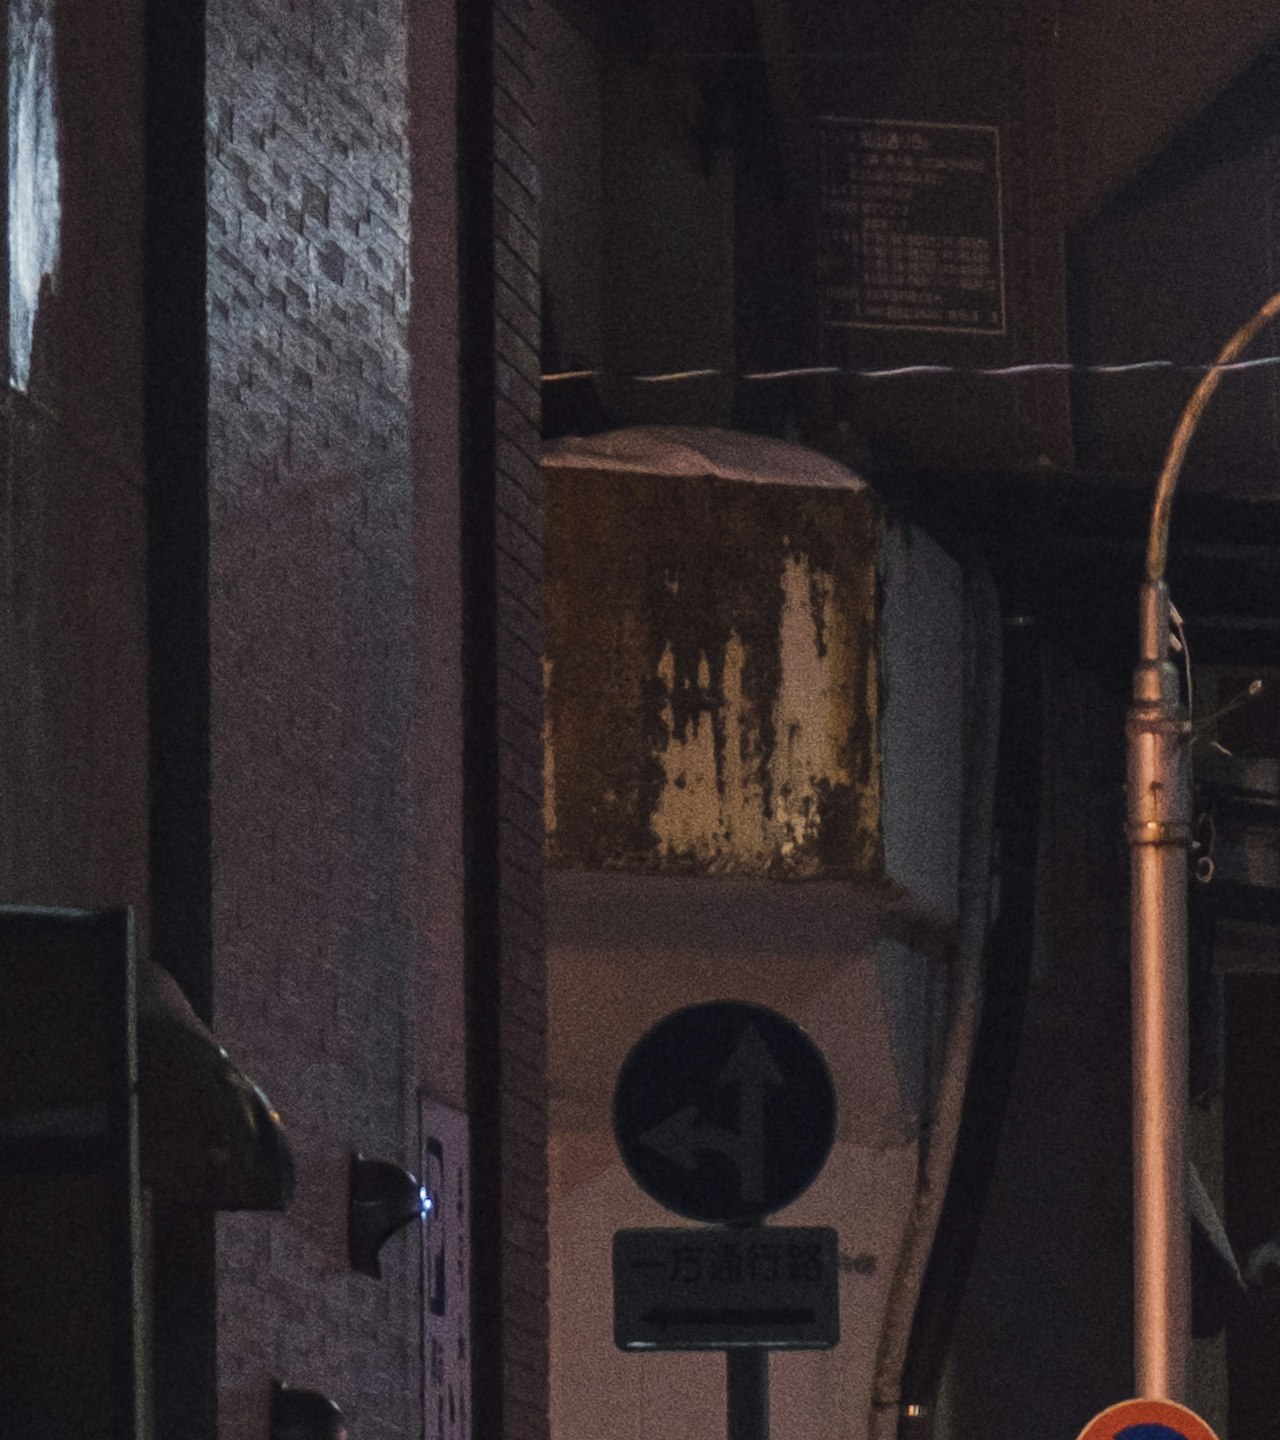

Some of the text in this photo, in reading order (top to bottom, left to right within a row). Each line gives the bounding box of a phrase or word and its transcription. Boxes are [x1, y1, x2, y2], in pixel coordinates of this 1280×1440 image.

[629, 1245, 825, 1284] 一方通行路
